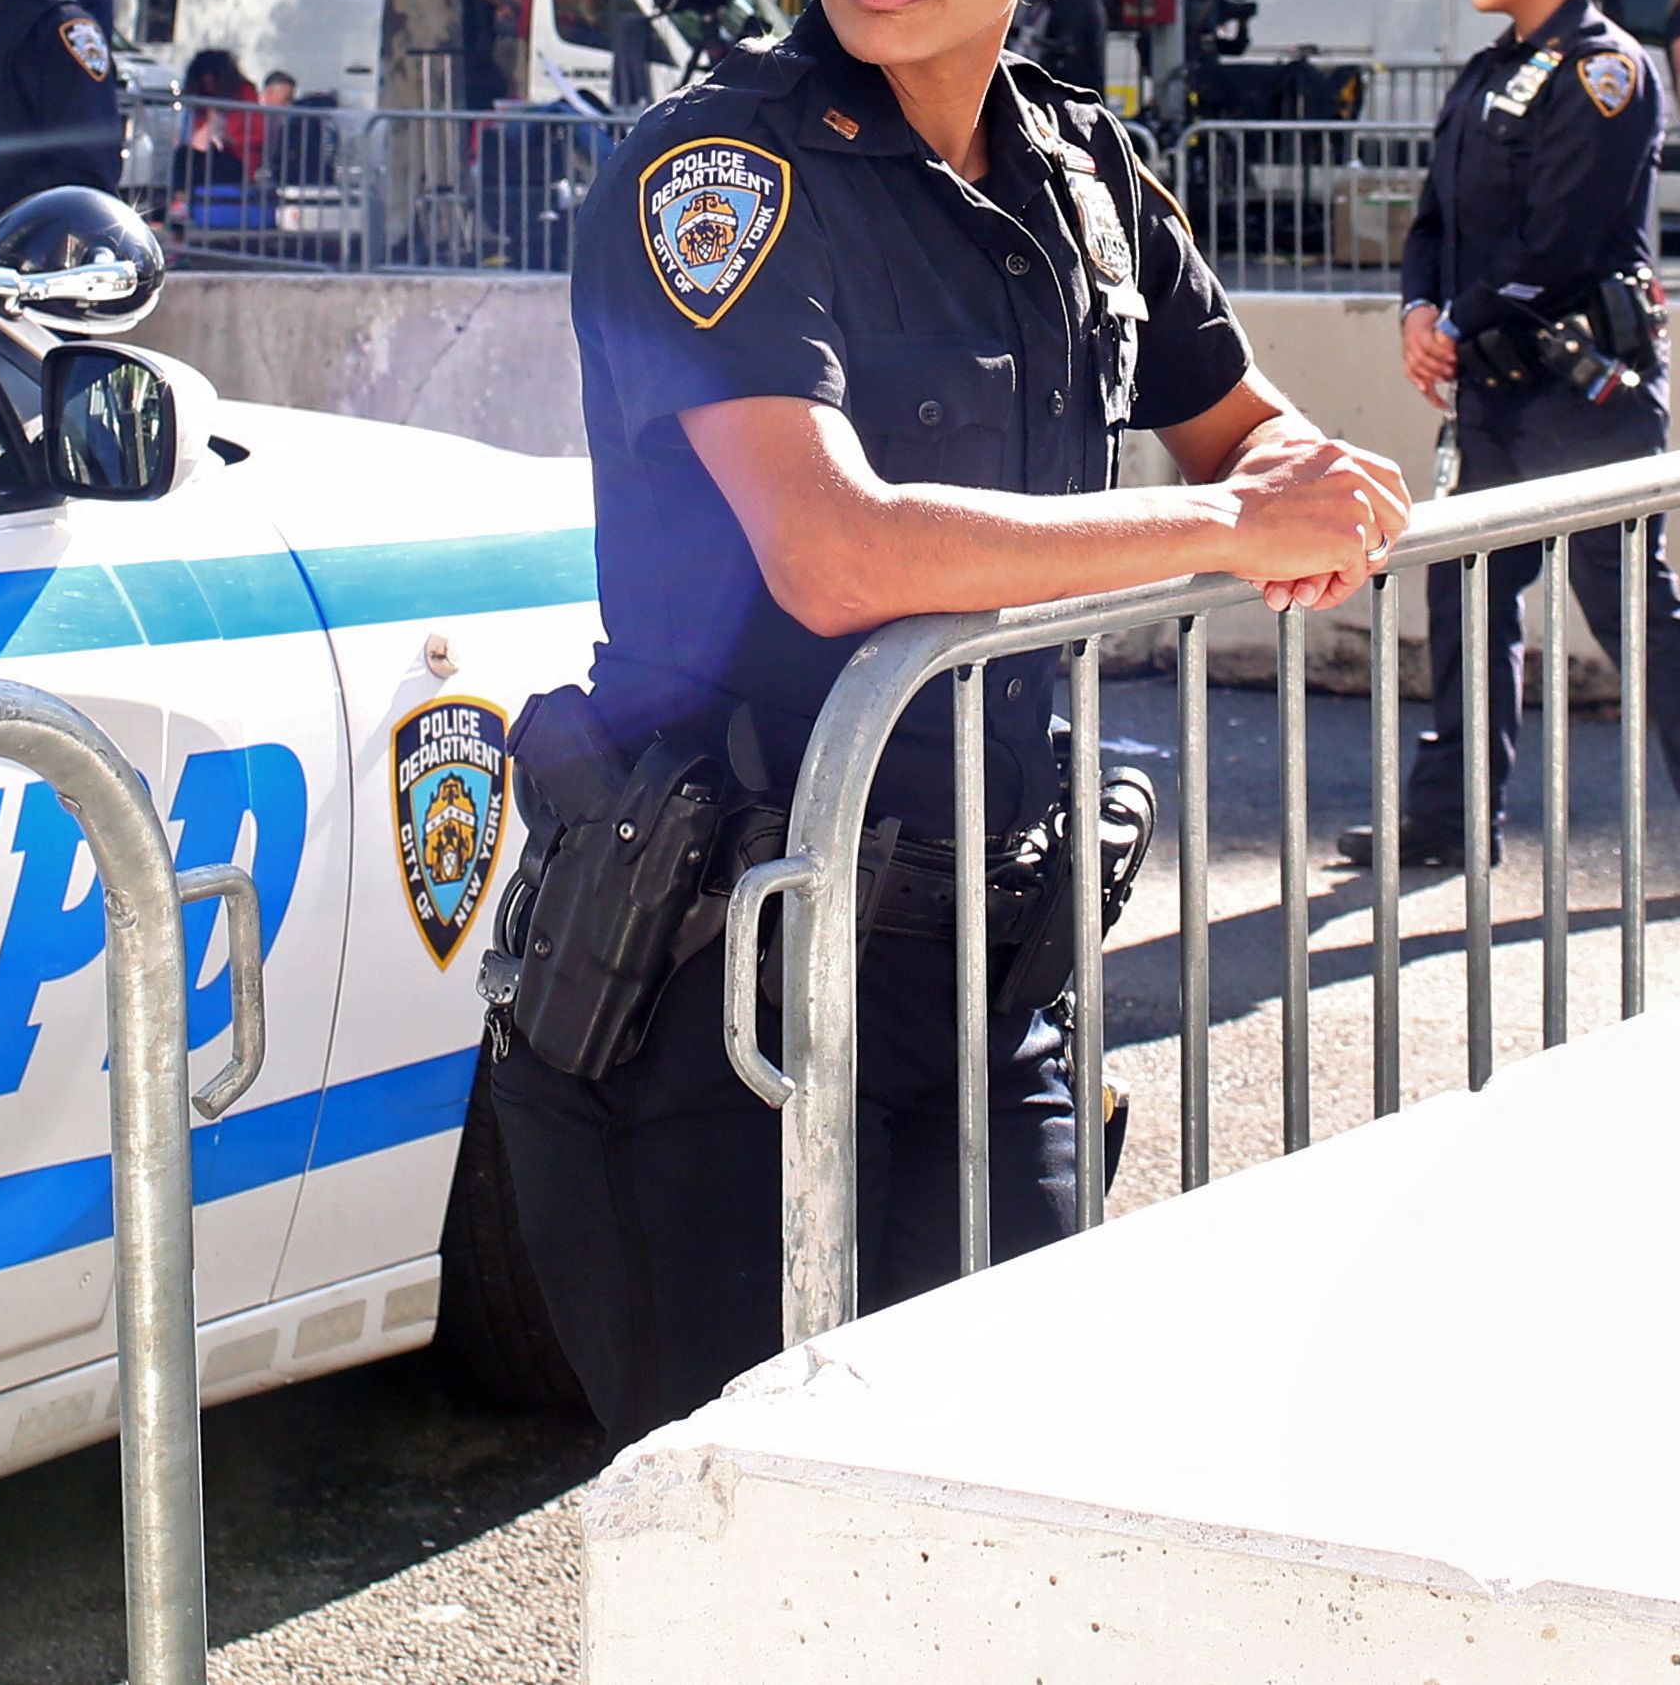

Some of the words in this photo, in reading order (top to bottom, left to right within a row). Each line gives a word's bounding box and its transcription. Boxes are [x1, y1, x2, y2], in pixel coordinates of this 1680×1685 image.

[651, 166, 775, 215] DEPARTMENT
[671, 149, 747, 178] POLICE
[652, 232, 678, 274] CITY
[673, 273, 695, 295] OF
[714, 253, 747, 296] NEW
[741, 204, 776, 252] YORK
[418, 708, 481, 745] POLICE
[398, 735, 502, 794] DEPARTMENT
[400, 821, 422, 884] CITY
[415, 890, 435, 922] OF
[453, 872, 483, 930] NEW
[478, 791, 503, 861] YORK
